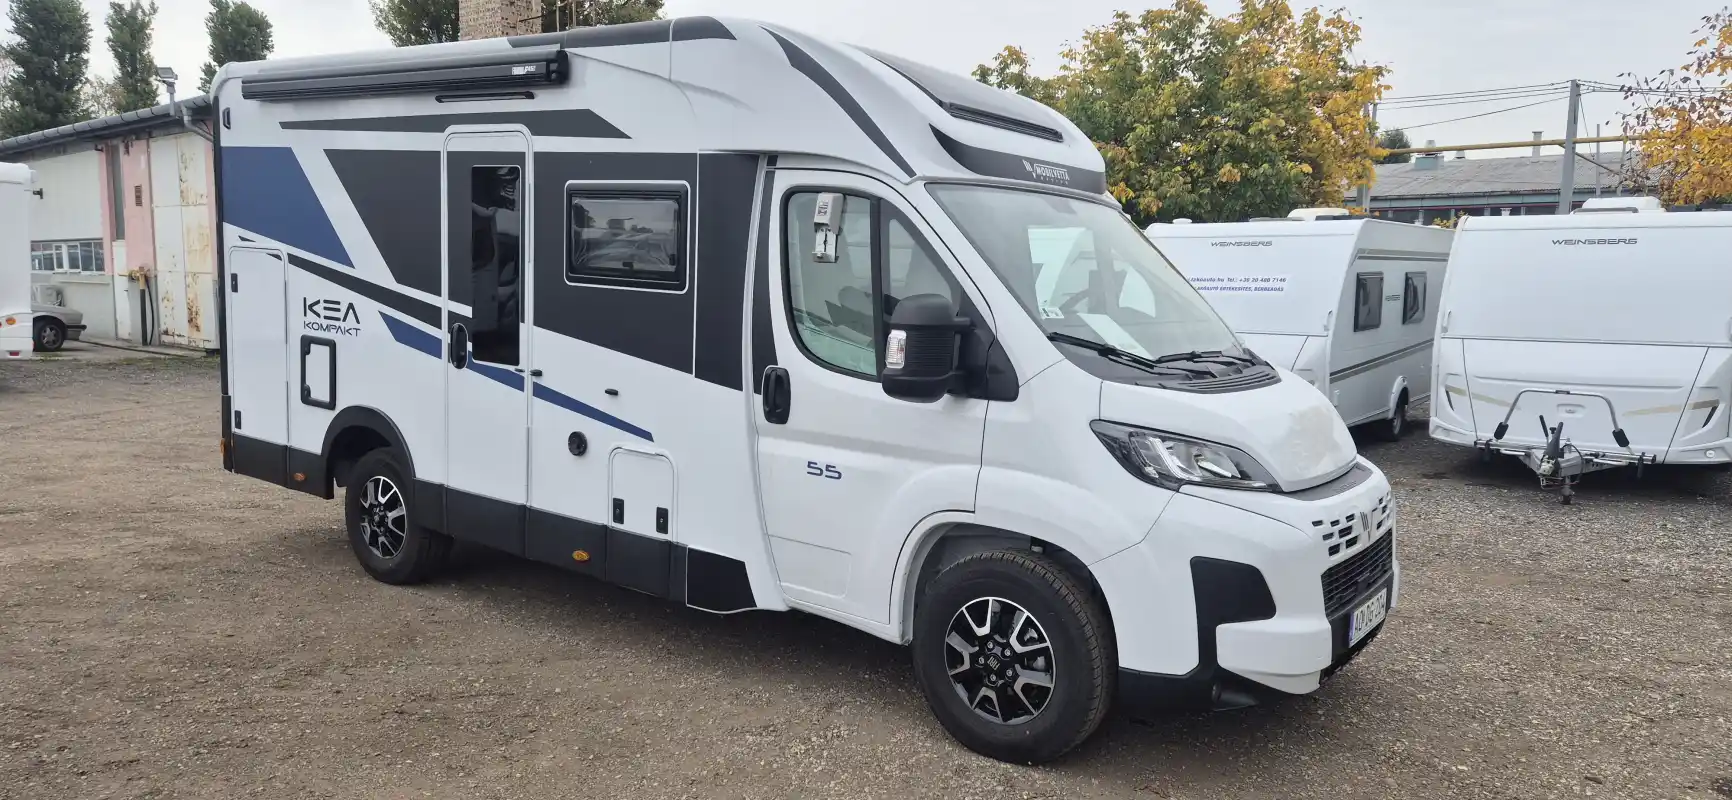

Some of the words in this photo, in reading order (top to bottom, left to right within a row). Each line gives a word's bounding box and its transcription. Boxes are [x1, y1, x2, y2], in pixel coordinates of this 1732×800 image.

[1552, 238, 1638, 246] WEINSBERG
[303, 296, 361, 325] KEA
[303, 320, 361, 337] KOMPAKT
[806, 461, 842, 480] 55
